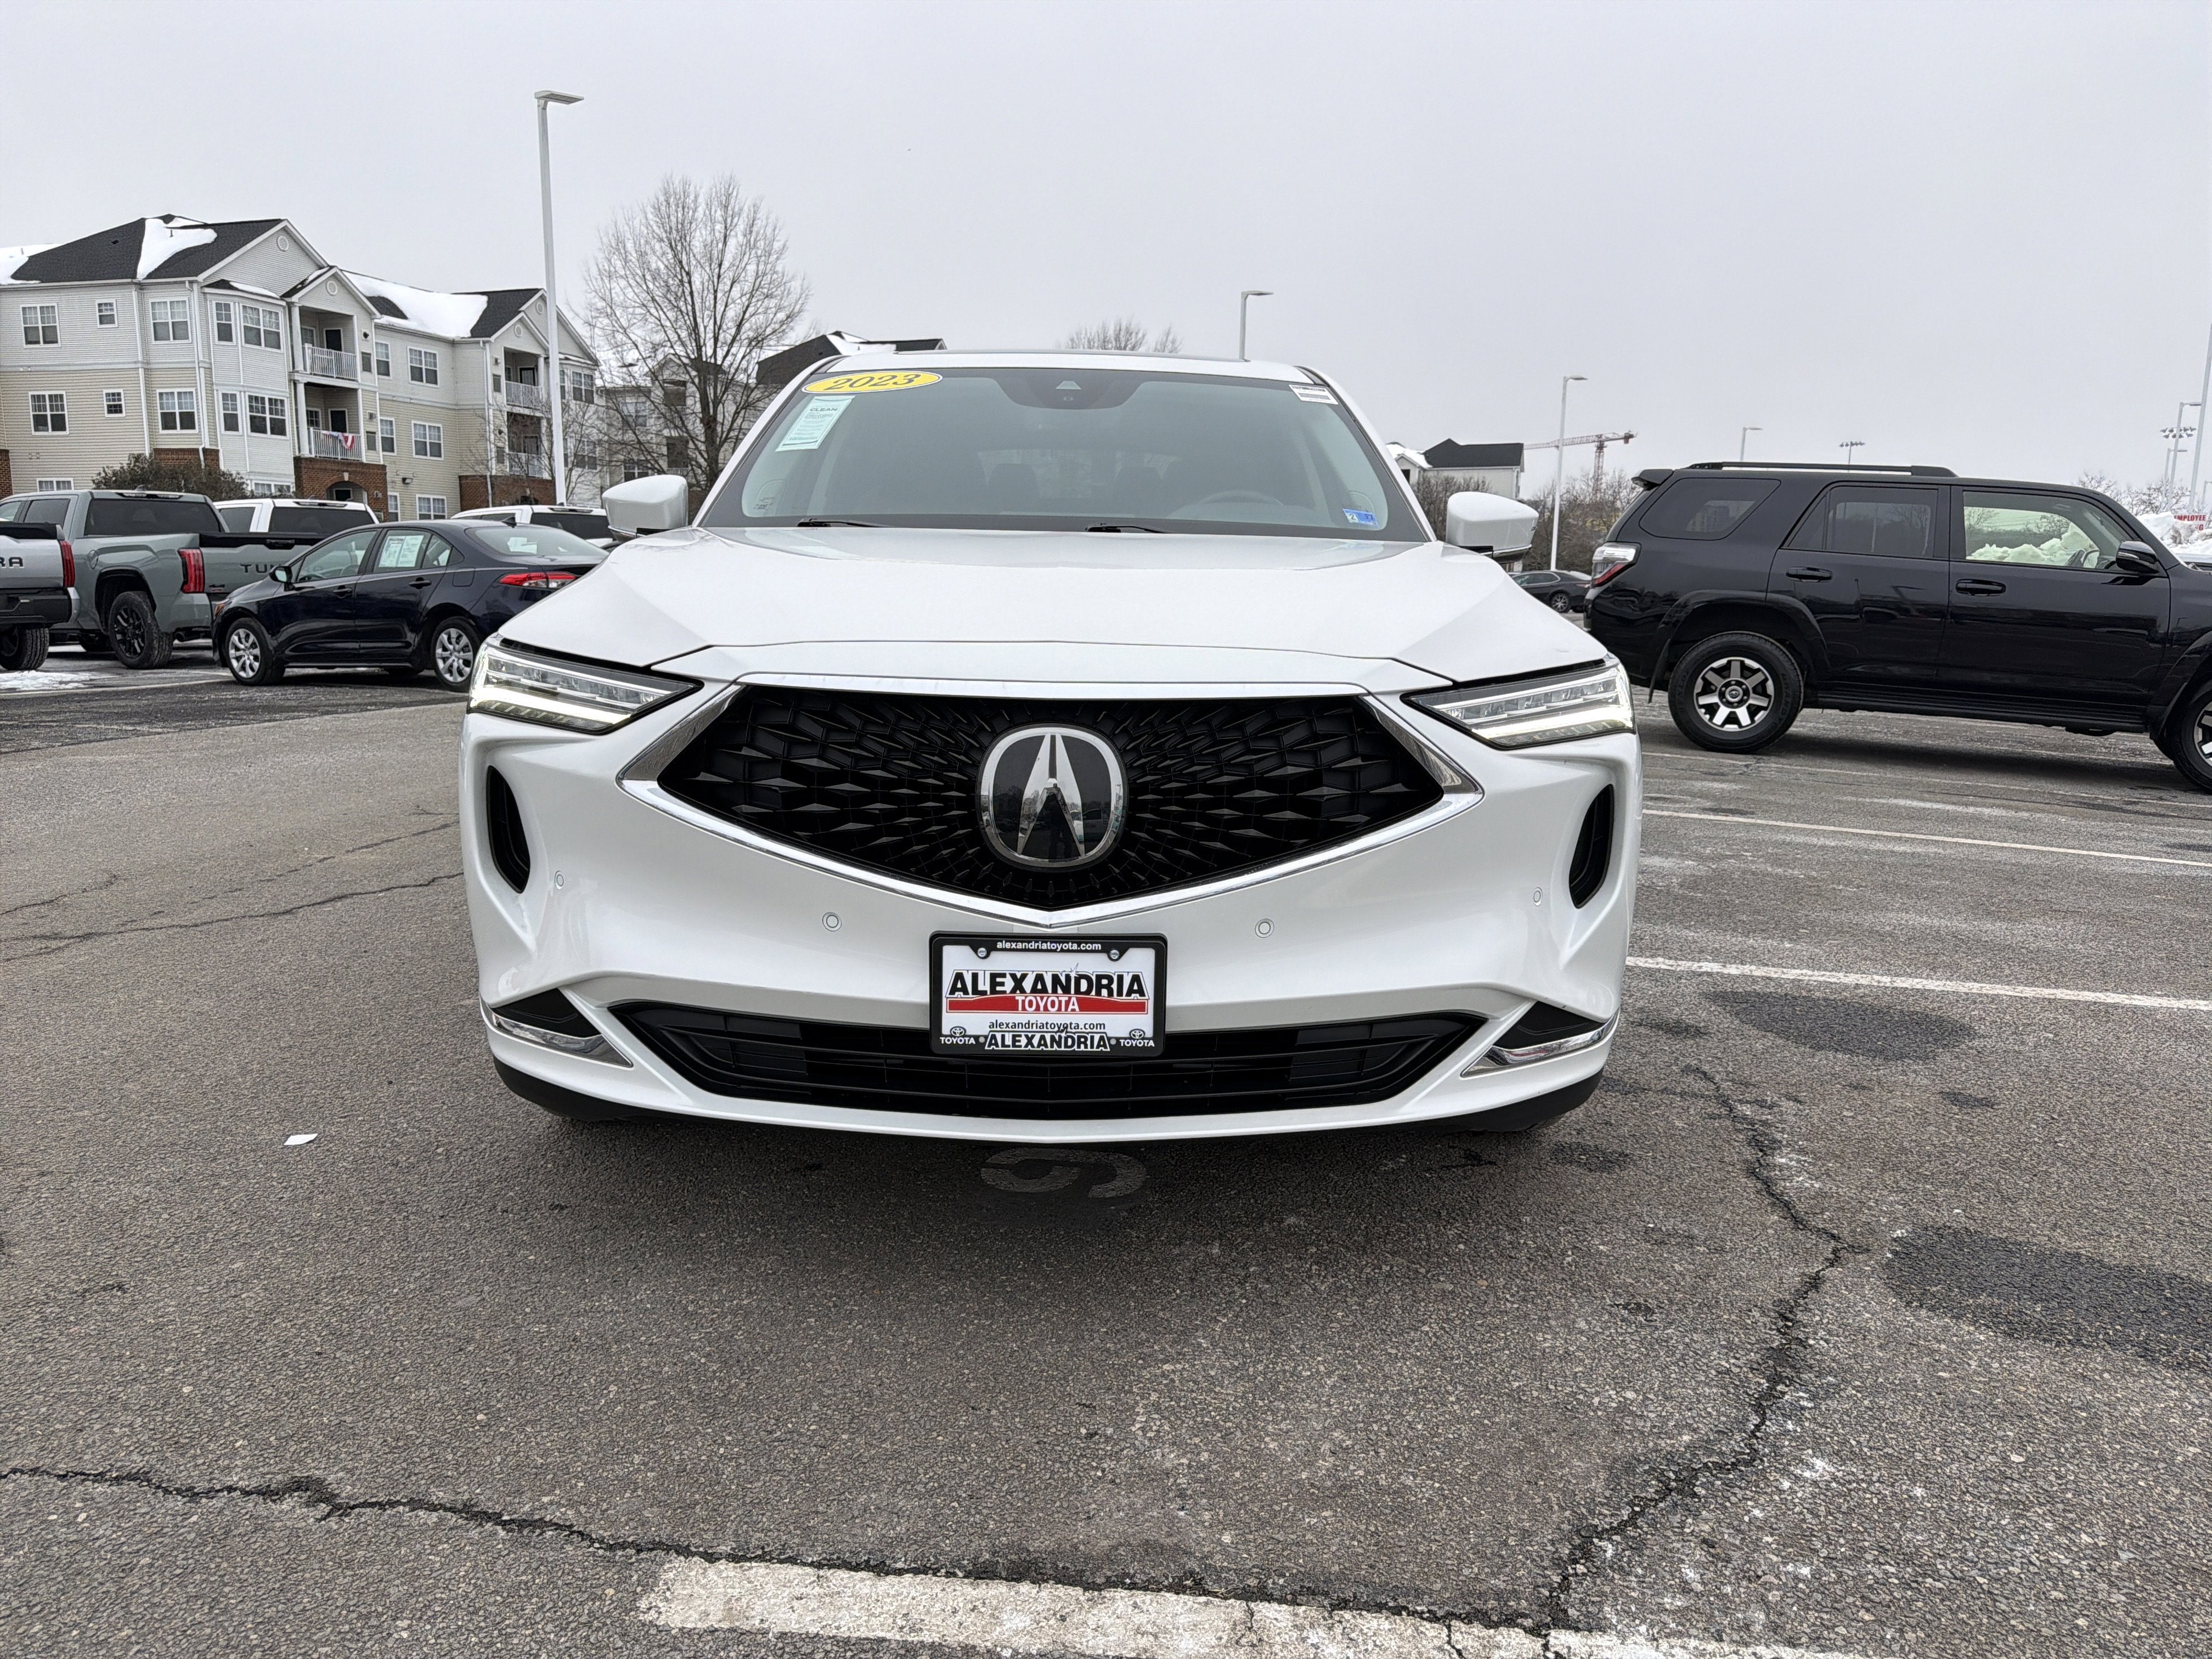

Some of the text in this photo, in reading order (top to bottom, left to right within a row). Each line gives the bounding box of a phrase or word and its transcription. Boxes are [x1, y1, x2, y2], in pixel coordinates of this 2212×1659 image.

[823, 374, 921, 391] 2023
[996, 940, 1102, 952] alexandriatoyota.com
[947, 970, 1148, 999] ALEXANDRIA
[1015, 996, 1080, 1012] TOYOTA
[989, 1019, 1105, 1033] alexandriatoyota.com
[940, 1037, 976, 1045] TOYOTA
[985, 1032, 1110, 1051] ALEXANDRIA
[1119, 1039, 1155, 1048] TOYOTA
